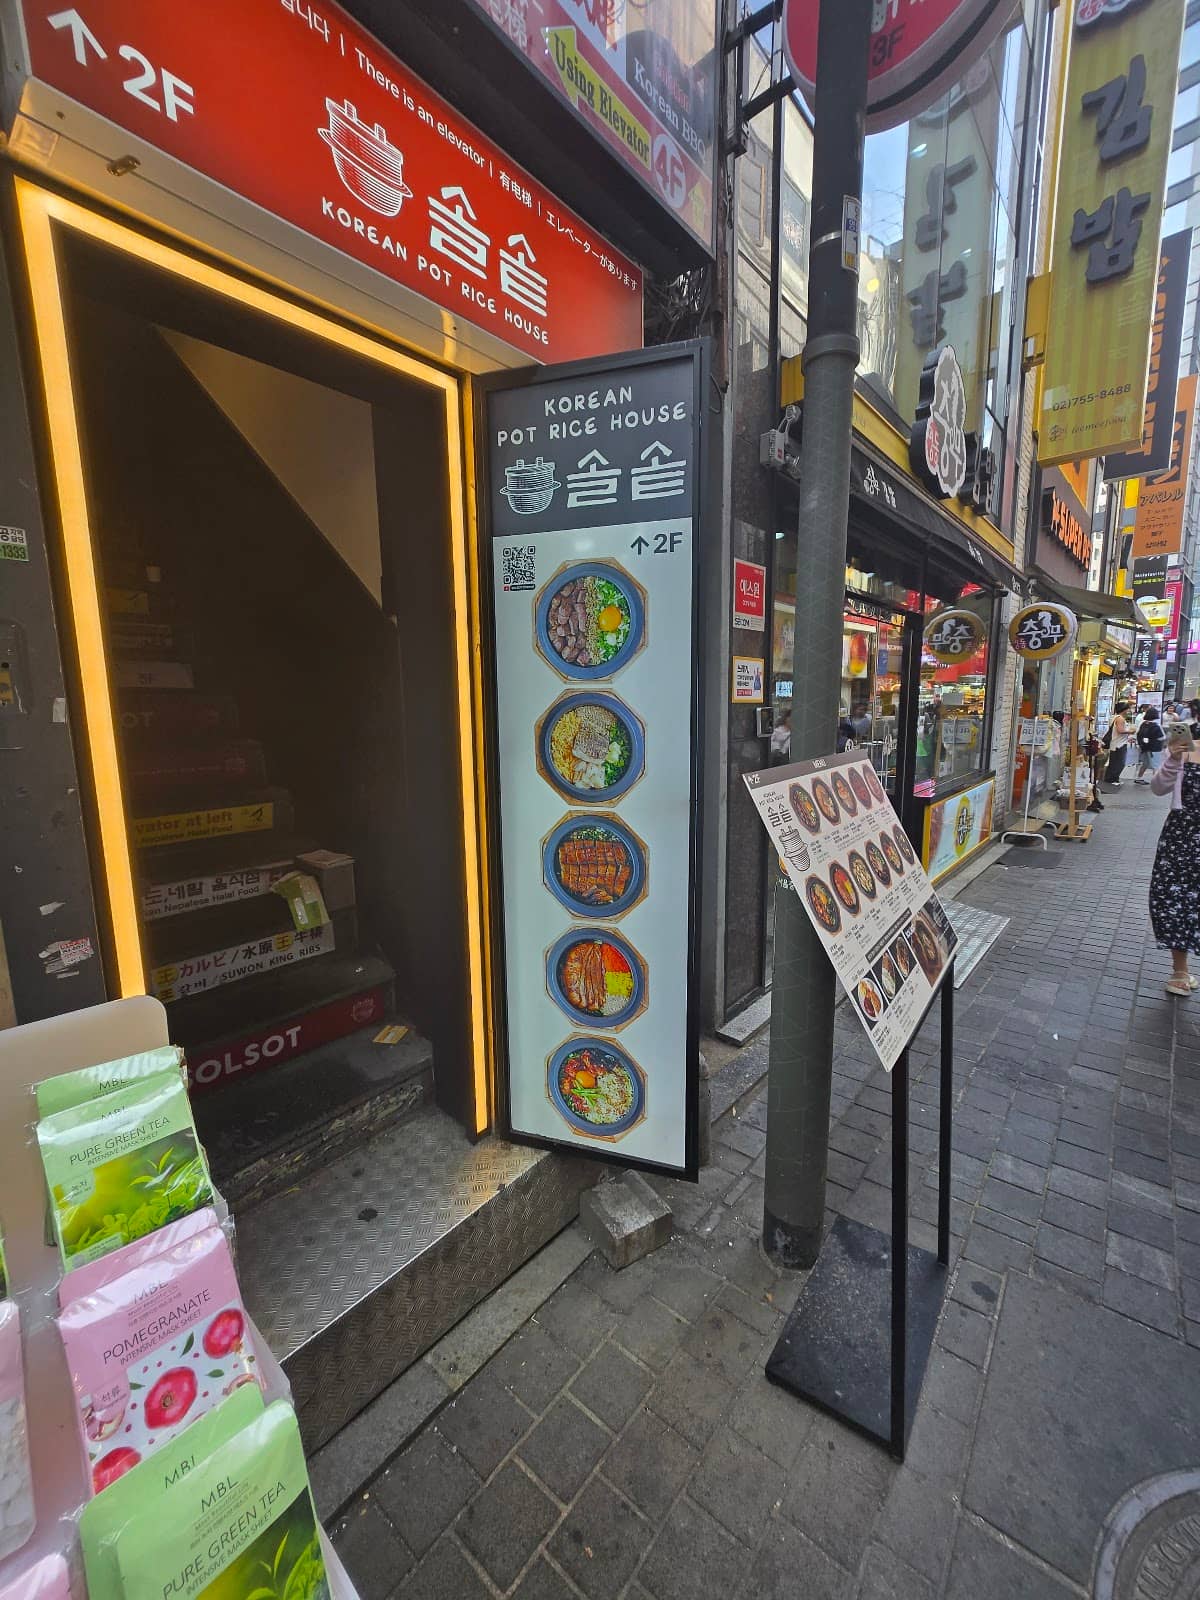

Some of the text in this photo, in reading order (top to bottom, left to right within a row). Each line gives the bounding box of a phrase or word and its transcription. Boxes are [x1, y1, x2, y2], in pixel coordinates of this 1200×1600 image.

[871, 22, 906, 66] 3F
[119, 44, 194, 122] 2F
[355, 48, 485, 167] There is an elevator
[554, 33, 650, 163] Using Elevator
[634, 57, 679, 129] Korean
[500, 171, 532, 208] 有电梯
[655, 143, 683, 200] 4F
[1071, 54, 1153, 284] 김밥
[322, 197, 549, 345] KOREAN POT RICE HOUSE
[427, 186, 548, 317] 솔솥
[546, 210, 638, 292] エレベーターがあります
[497, 402, 687, 447] POT RICE HOUSE
[544, 386, 633, 417] KOREAN
[566, 440, 687, 508] 솔솥
[653, 531, 683, 554] 2F
[238, 885, 260, 897] Food
[222, 962, 264, 981] SUWON
[269, 953, 294, 966] KING
[299, 943, 321, 957] RIBS
[69, 1116, 171, 1166] PURE GREEN TEA
[87, 1149, 120, 1166] INTENSIVE
[103, 1288, 212, 1365] POMEGRANATE
[120, 1310, 202, 1366] INTENSIVE MASK SHEET
[201, 1476, 239, 1512] MBL
[162, 1554, 205, 1600] PURE
[207, 1506, 257, 1559] GREEN
[259, 1481, 287, 1509] TEA
[186, 1509, 273, 1595] INTENSIVE MASK SHEET
